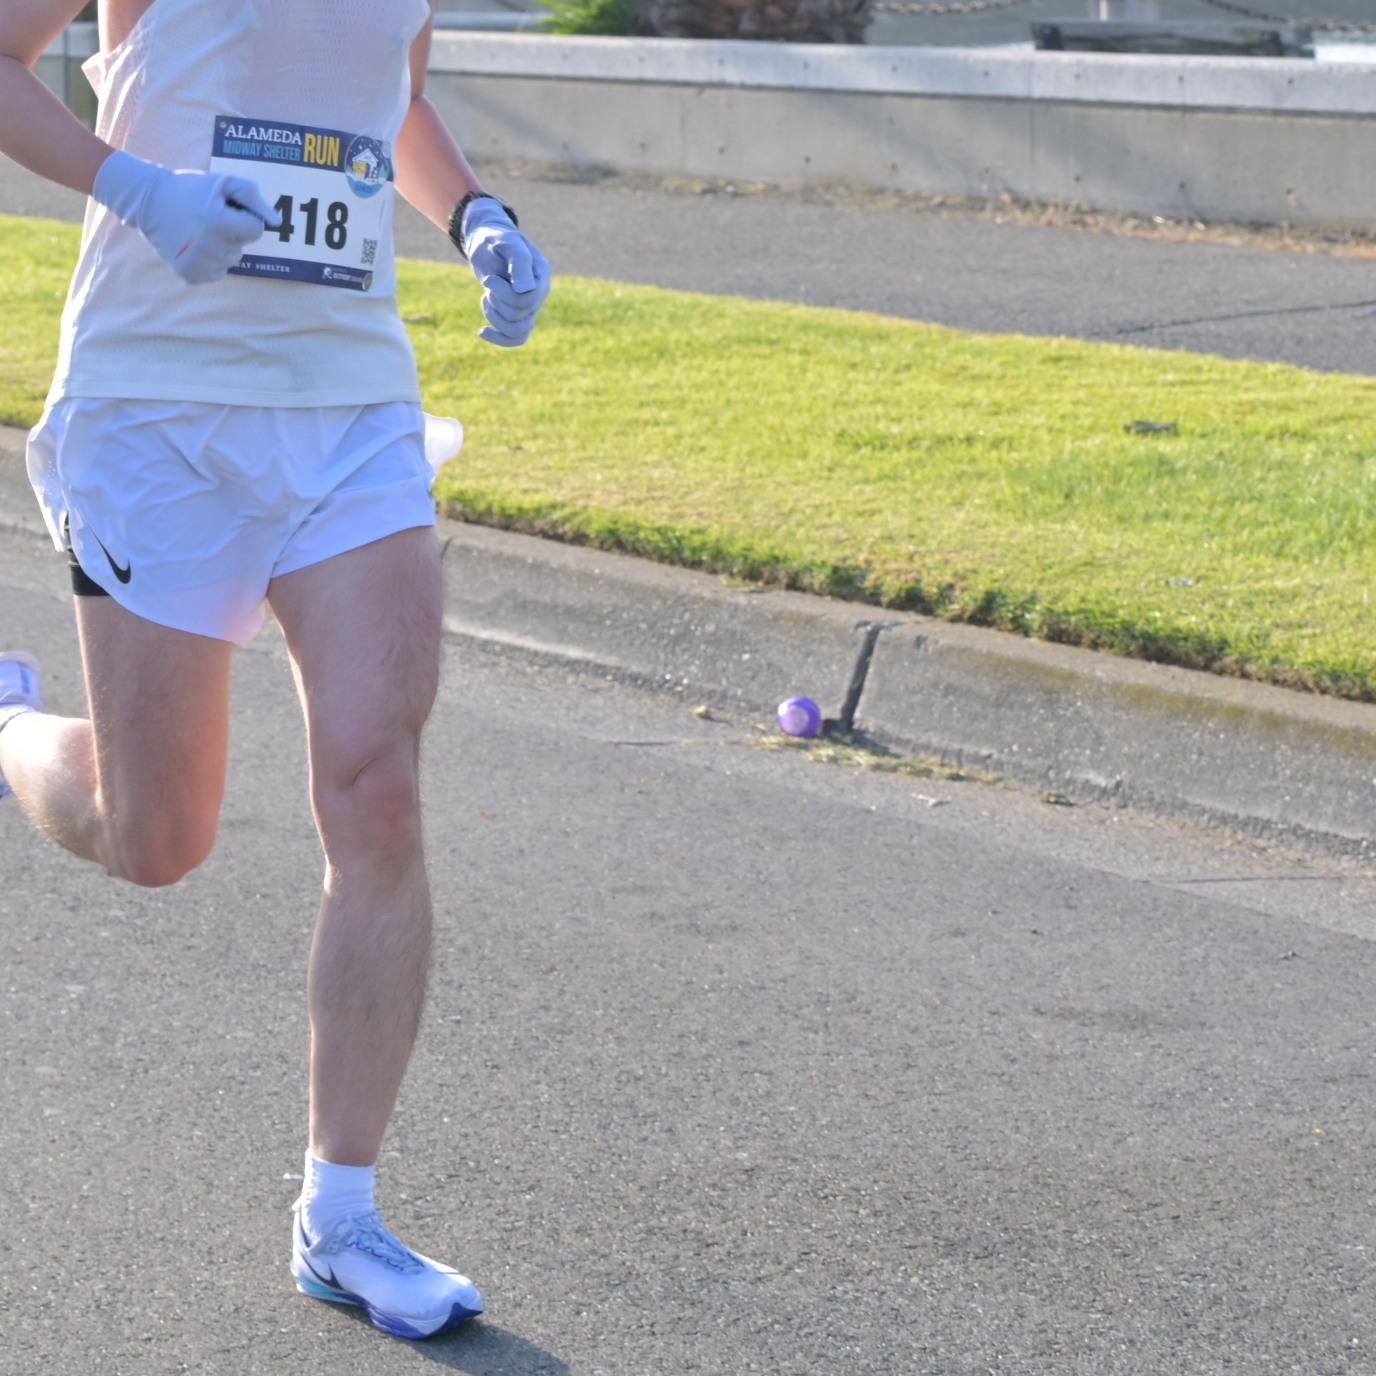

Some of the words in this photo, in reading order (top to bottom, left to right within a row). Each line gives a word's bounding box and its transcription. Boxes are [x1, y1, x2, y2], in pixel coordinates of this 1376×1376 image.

[224, 125, 302, 145] ALAMEDA
[223, 140, 263, 157] MIDWAY
[263, 144, 301, 162] SHELTER
[303, 133, 341, 167] RUN
[264, 194, 349, 250] 418
[234, 261, 252, 270] WAY
[255, 263, 291, 273] SHELTER
